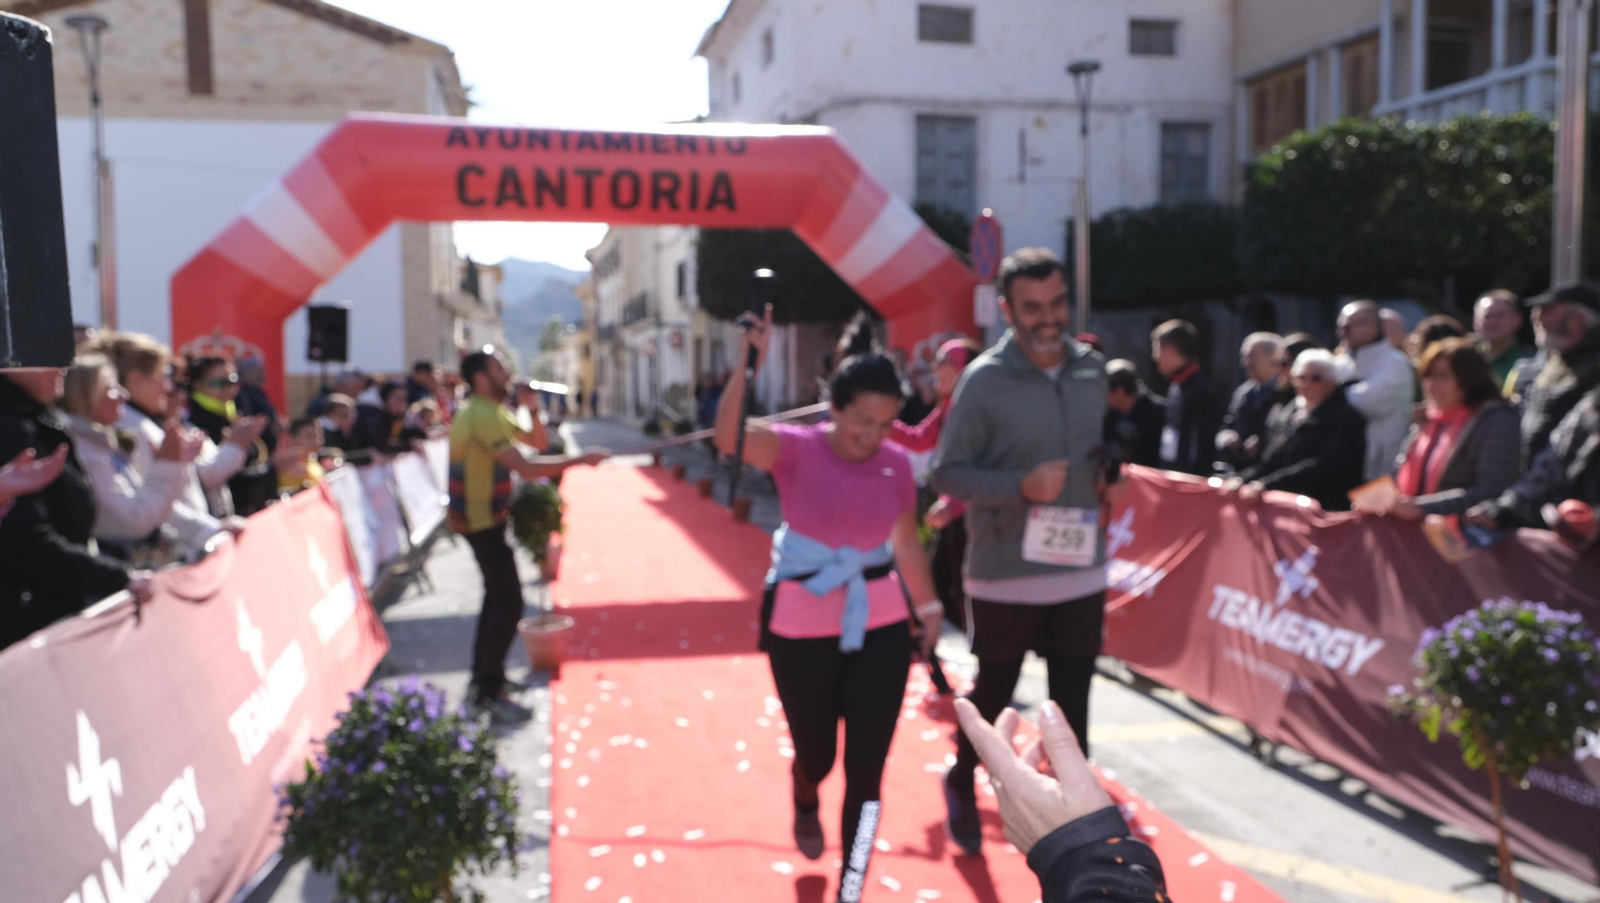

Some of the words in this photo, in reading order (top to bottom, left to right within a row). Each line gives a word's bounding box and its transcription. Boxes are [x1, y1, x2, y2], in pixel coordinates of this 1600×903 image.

[446, 127, 747, 156] AYUNTAMIENTO
[456, 164, 738, 212] CANTORIA
[1042, 526, 1086, 552] 259
